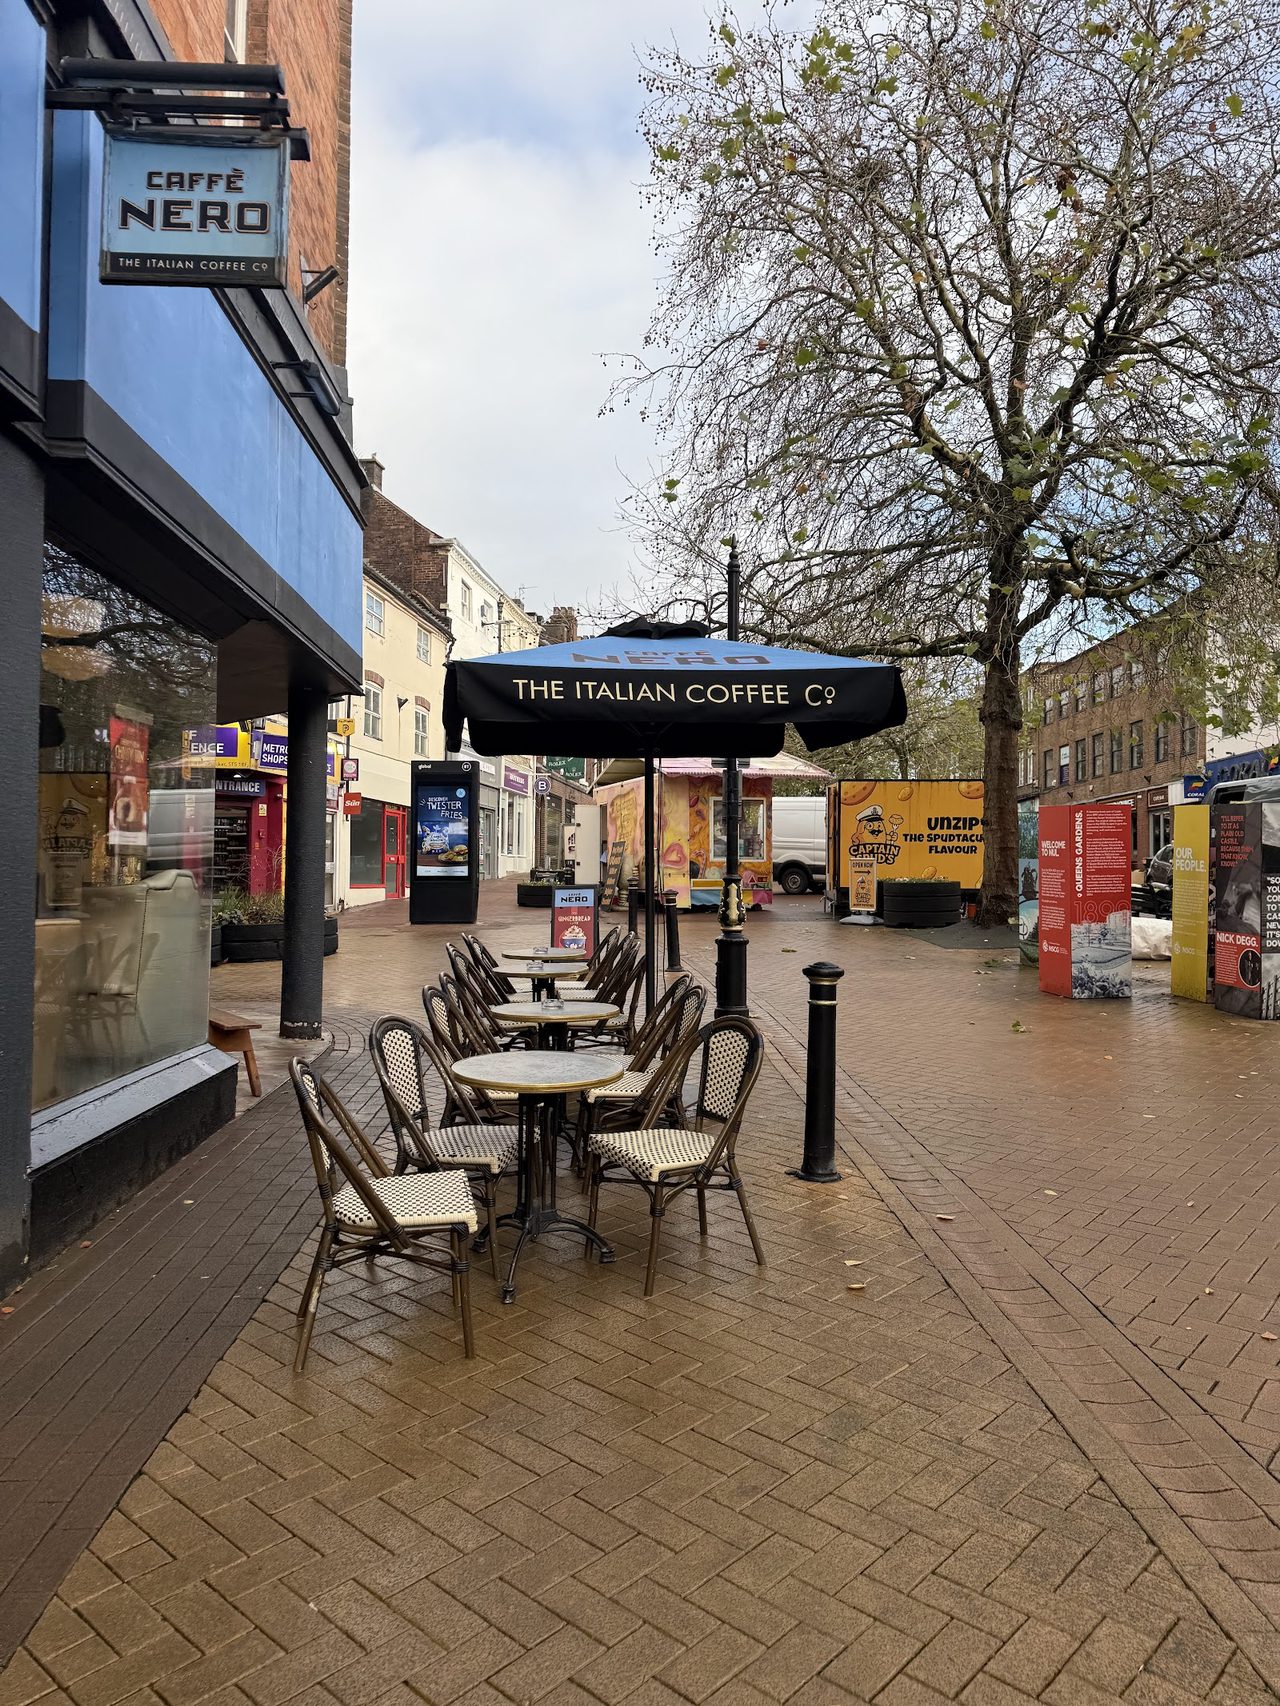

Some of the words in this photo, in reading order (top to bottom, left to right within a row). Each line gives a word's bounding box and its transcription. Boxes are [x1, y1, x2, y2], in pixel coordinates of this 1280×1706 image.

[146, 167, 244, 193] CAFFÈ
[118, 197, 270, 234] NERO
[118, 258, 140, 267] THE
[146, 259, 194, 270] ITALIAN
[200, 260, 246, 271] COFFEE
[571, 653, 772, 665] NERO
[512, 679, 564, 700] THE
[575, 681, 676, 702] ITALIAN
[685, 684, 790, 705] COFFEE
[190, 743, 225, 754] ENCE
[262, 753, 288, 765] SHOPS
[215, 780, 260, 793] NTRANCE
[538, 781, 547, 790] B
[426, 800, 462, 810] TWISTER
[440, 810, 463, 820] FRIES
[927, 833, 984, 843] SPUDTACU
[1075, 810, 1083, 855] GARDENS.
[849, 843, 900, 856] CAPTAIN
[928, 845, 978, 855] FLAVOUR
[1041, 840, 1066, 849] WELCOME
[1041, 848, 1049, 856] TO
[1175, 847, 1193, 859] OUR
[1175, 860, 1207, 873] PEOPLE.
[1075, 857, 1083, 892] QUEENS
[1216, 932, 1235, 944] NICK
[1236, 934, 1259, 948] DEGG.
